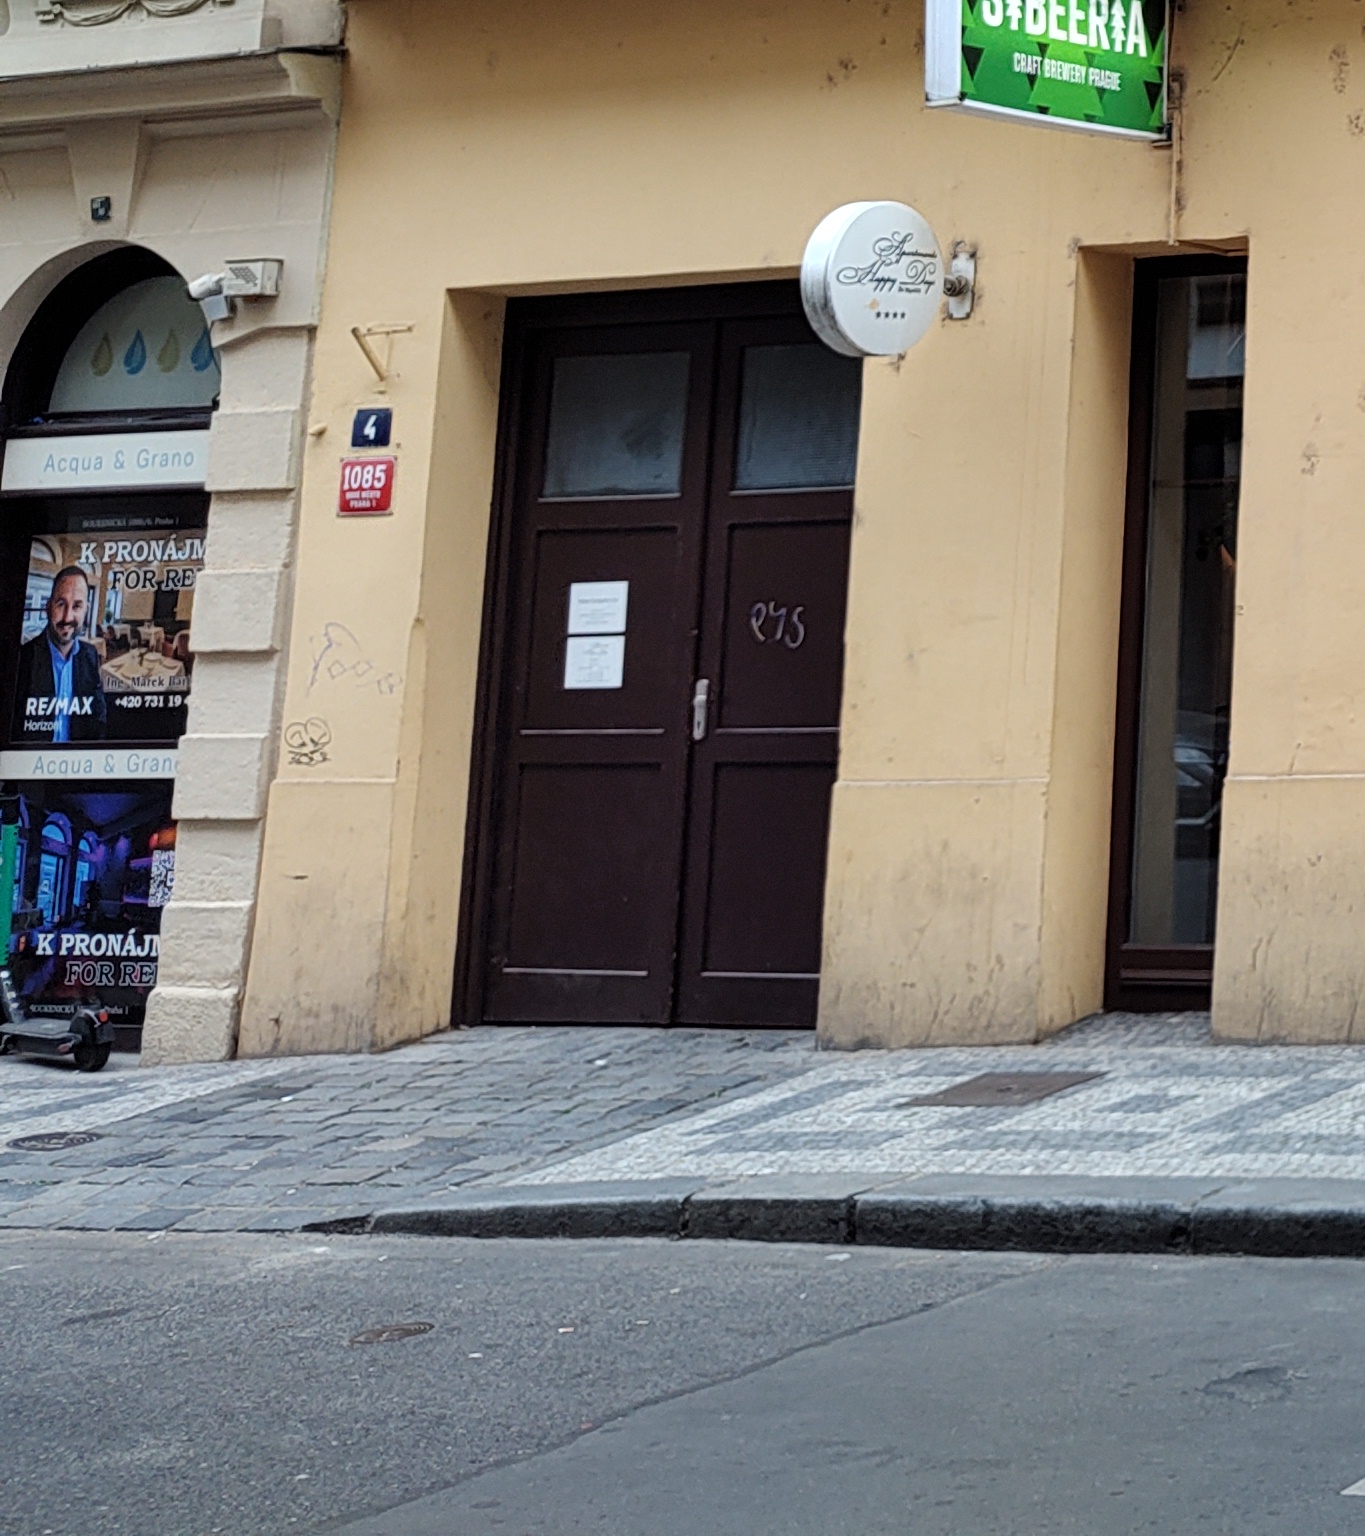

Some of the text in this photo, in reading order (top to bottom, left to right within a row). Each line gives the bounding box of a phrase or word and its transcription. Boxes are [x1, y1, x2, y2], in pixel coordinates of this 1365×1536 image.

[1013, 52, 1121, 91] CRAFT BREWERY PRAGUE
[363, 414, 378, 440] 4
[43, 448, 195, 475] Acqua & Grano
[343, 464, 387, 490] 1085
[78, 541, 98, 564] K
[110, 566, 203, 592] FOR RE
[25, 695, 94, 716] RE/MAX
[115, 695, 182, 708] +420 731 19
[32, 755, 93, 776] Acqua
[103, 753, 115, 774] &
[36, 933, 55, 956] K
[64, 960, 158, 987] FOR RE
